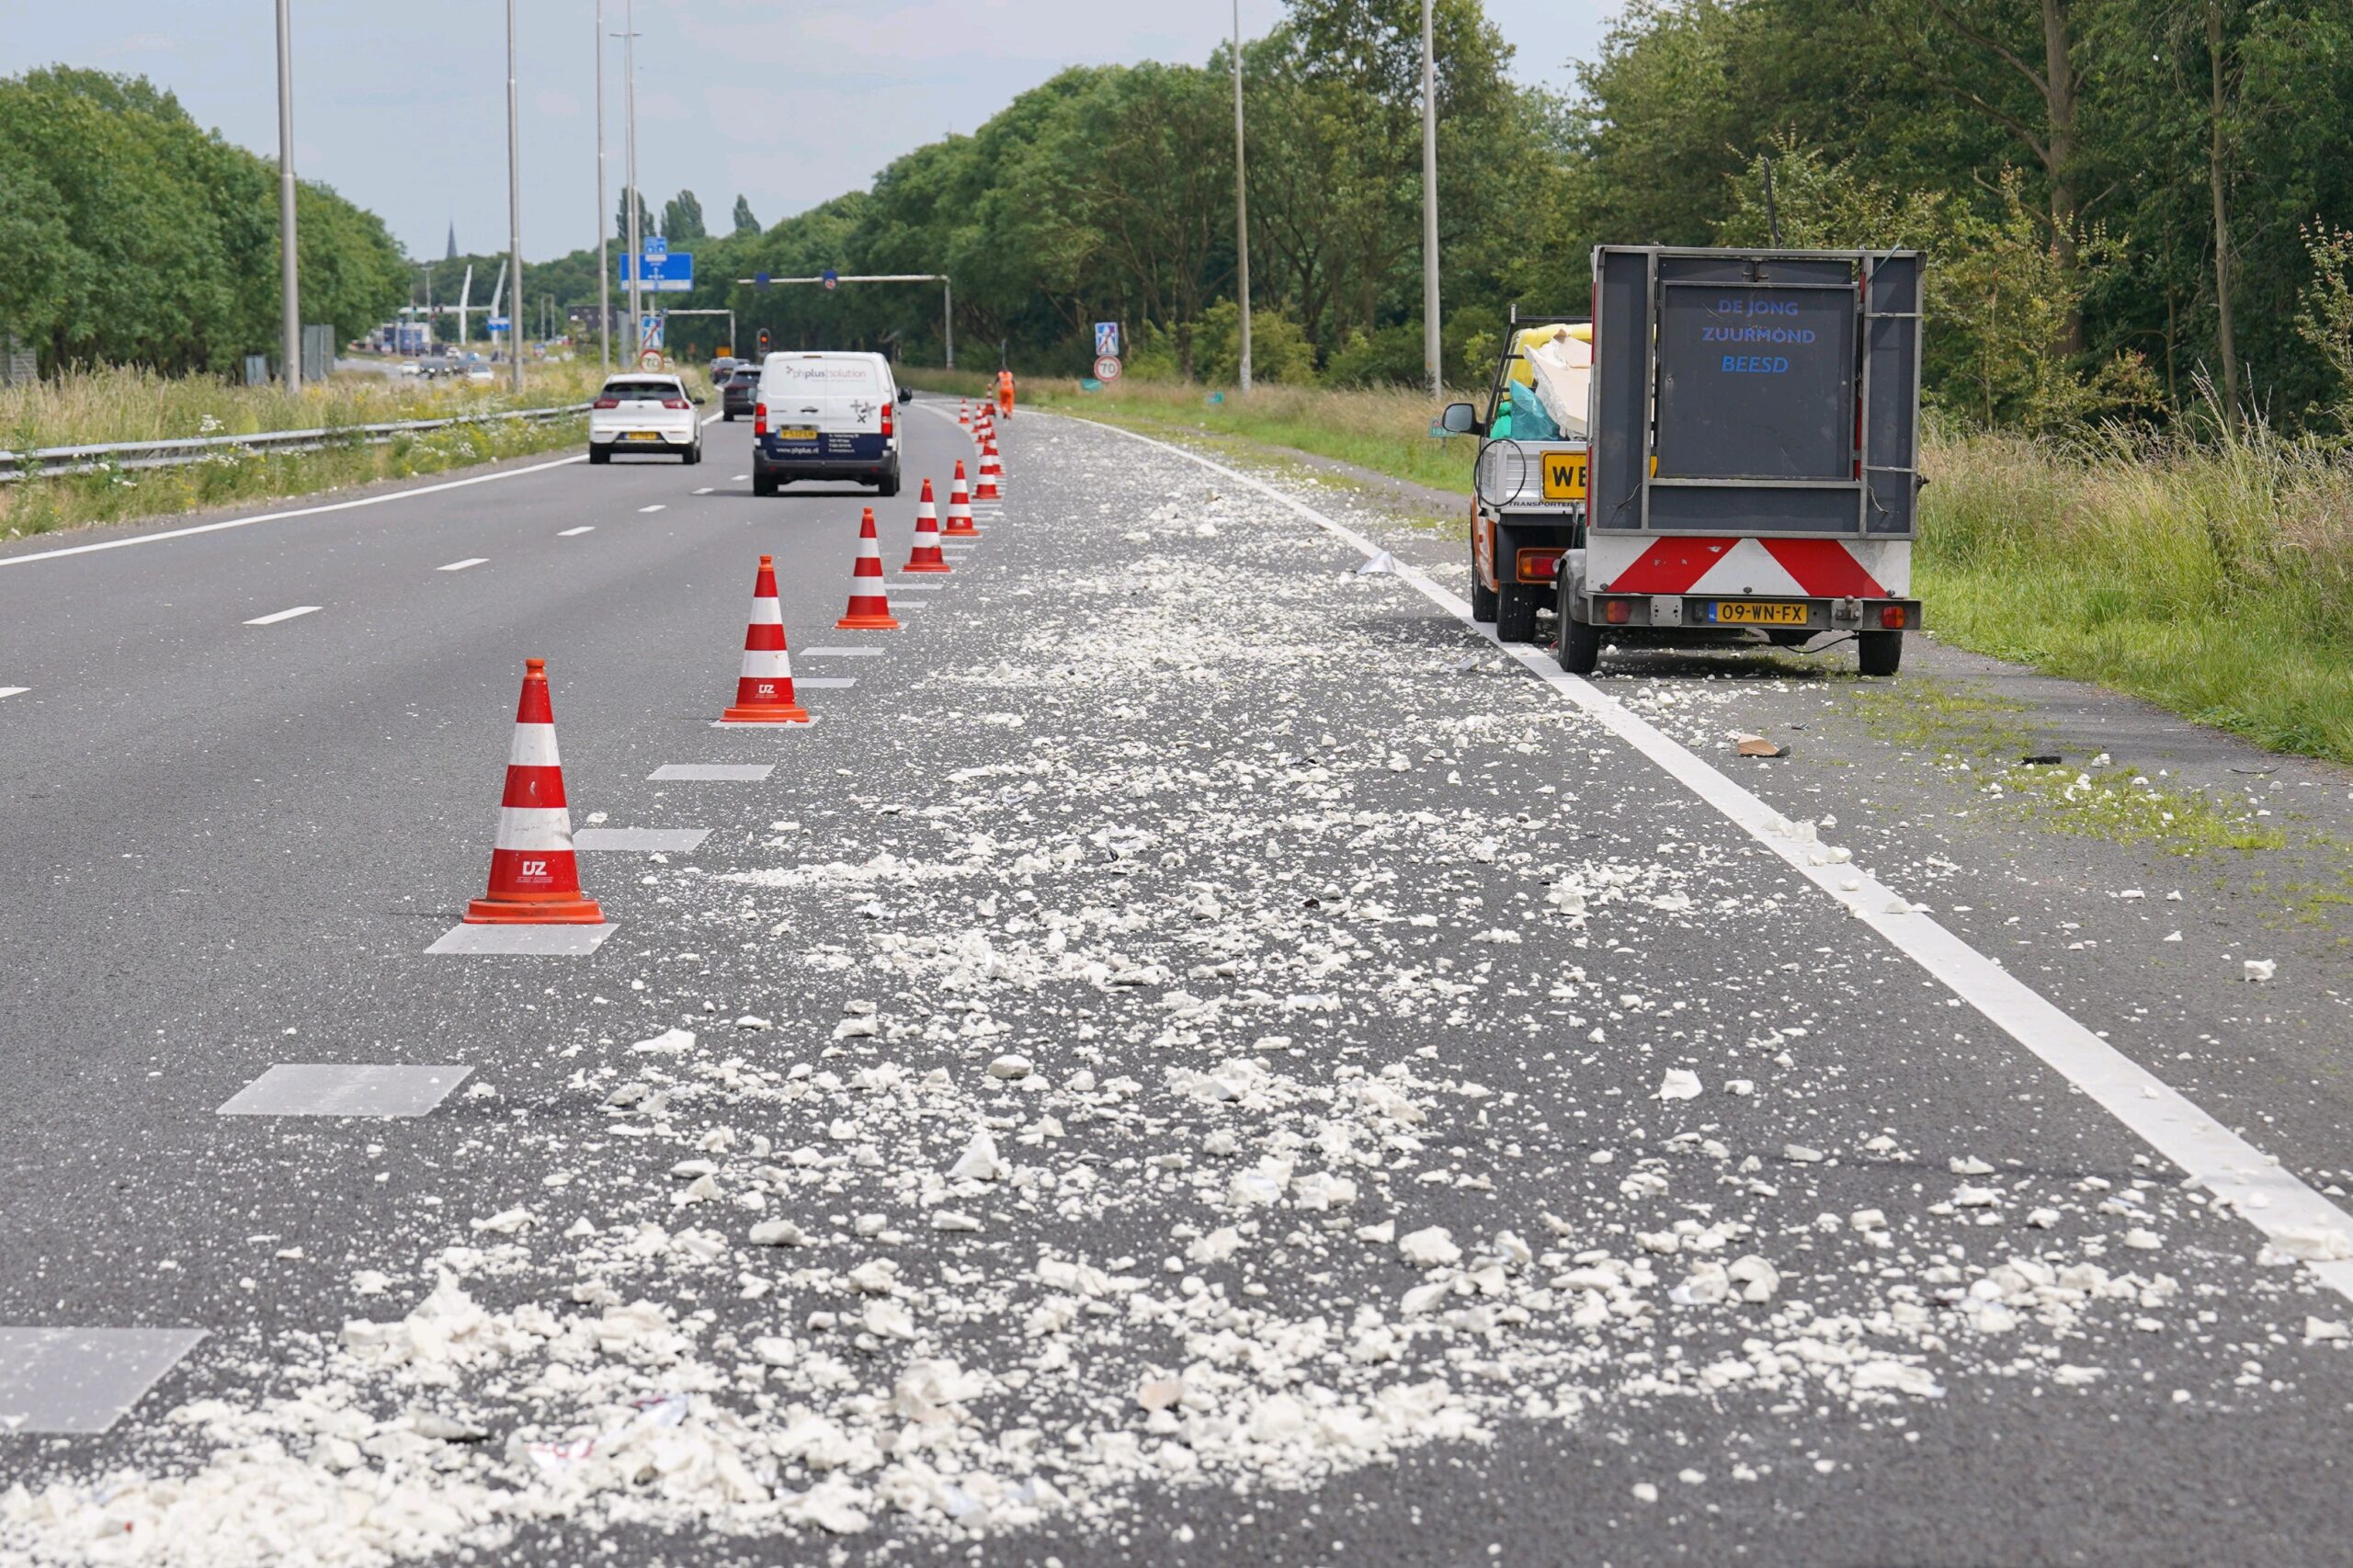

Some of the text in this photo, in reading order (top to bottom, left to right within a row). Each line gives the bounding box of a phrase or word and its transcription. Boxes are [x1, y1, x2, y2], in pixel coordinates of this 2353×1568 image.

[1718, 299, 1799, 317] DE JONG
[1701, 326, 1816, 344] ZUURMOND
[1099, 362, 1116, 374] 70
[1721, 355, 1789, 373] BEESD
[1722, 604, 1802, 621] 09-WN-FX
